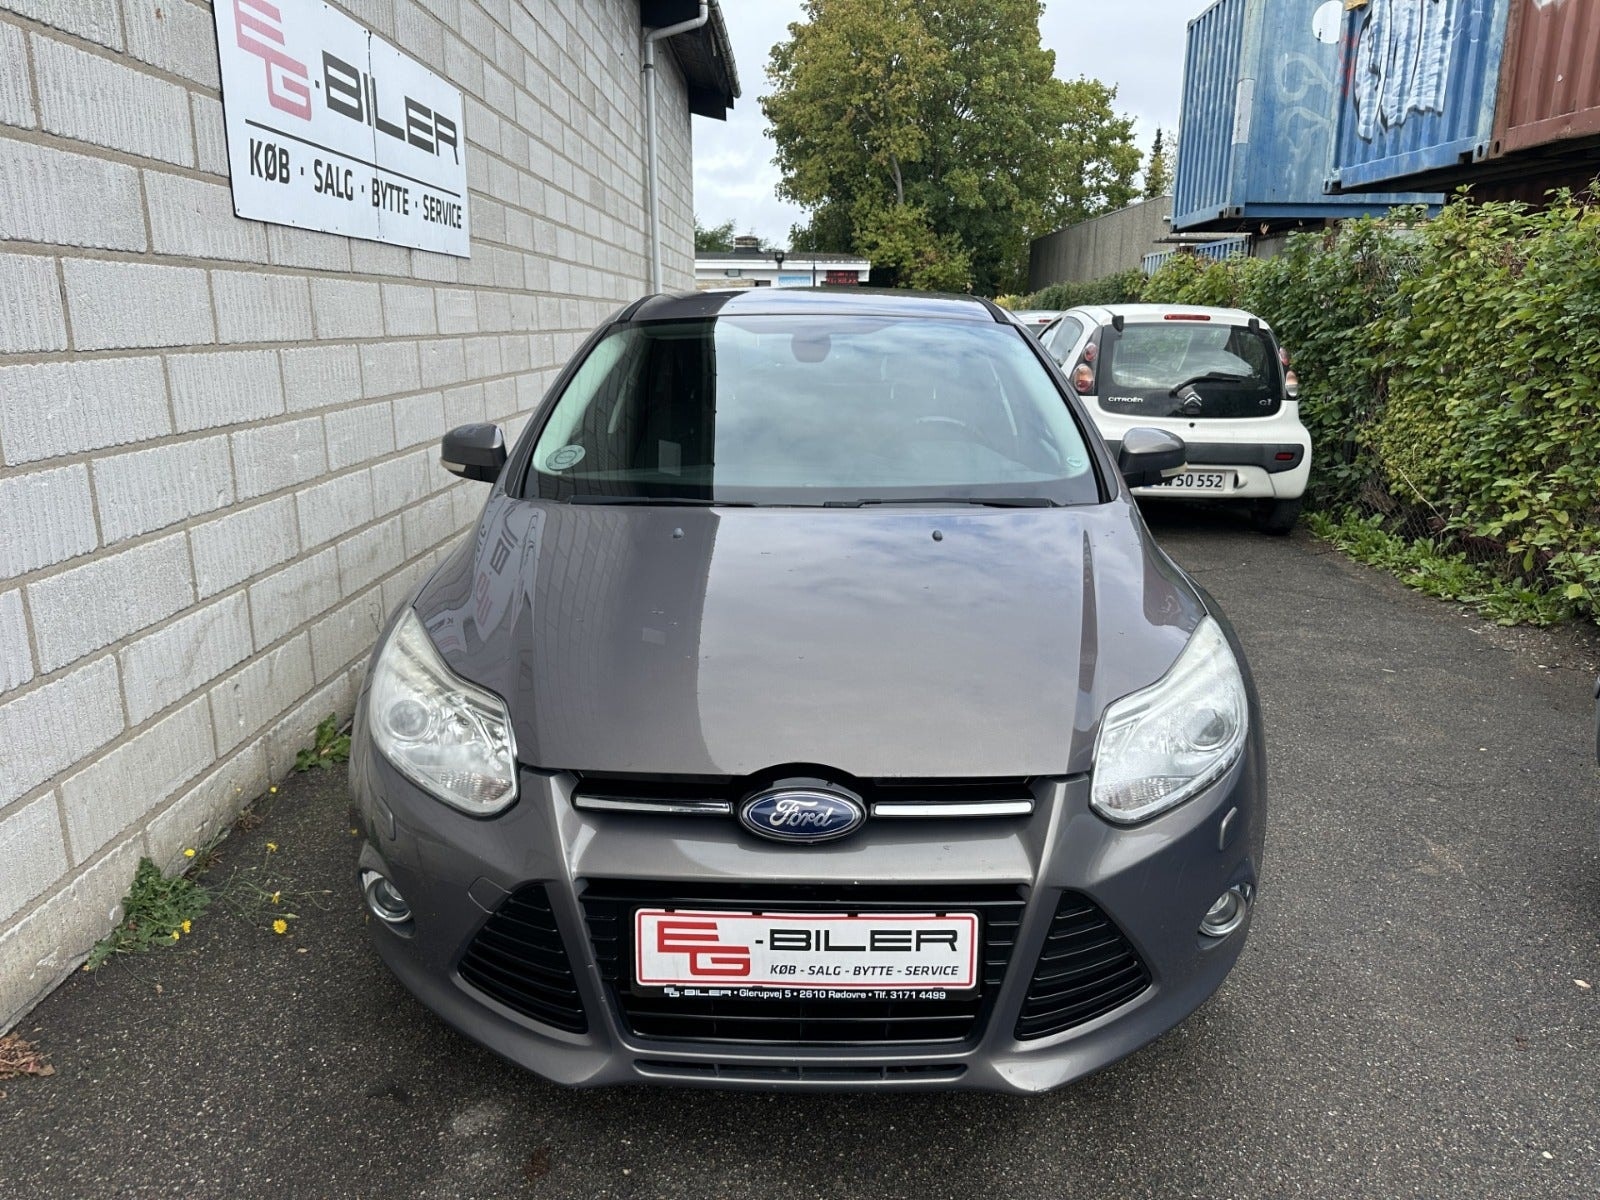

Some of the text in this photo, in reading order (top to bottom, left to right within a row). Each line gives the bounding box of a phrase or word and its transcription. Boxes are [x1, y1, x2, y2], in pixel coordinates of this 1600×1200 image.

[250, 138, 462, 229] KØB SALG BYTTE SERVICE
[1176, 474, 1194, 487] 50
[1197, 474, 1223, 488] 552
[770, 799, 834, 827] Ford
[770, 964, 959, 976] KØB SALG BYTTE SERVICE
[785, 989, 791, 998] 5
[799, 990, 826, 998] 2610
[890, 991, 916, 999] 3171
[919, 991, 946, 999] 4499
